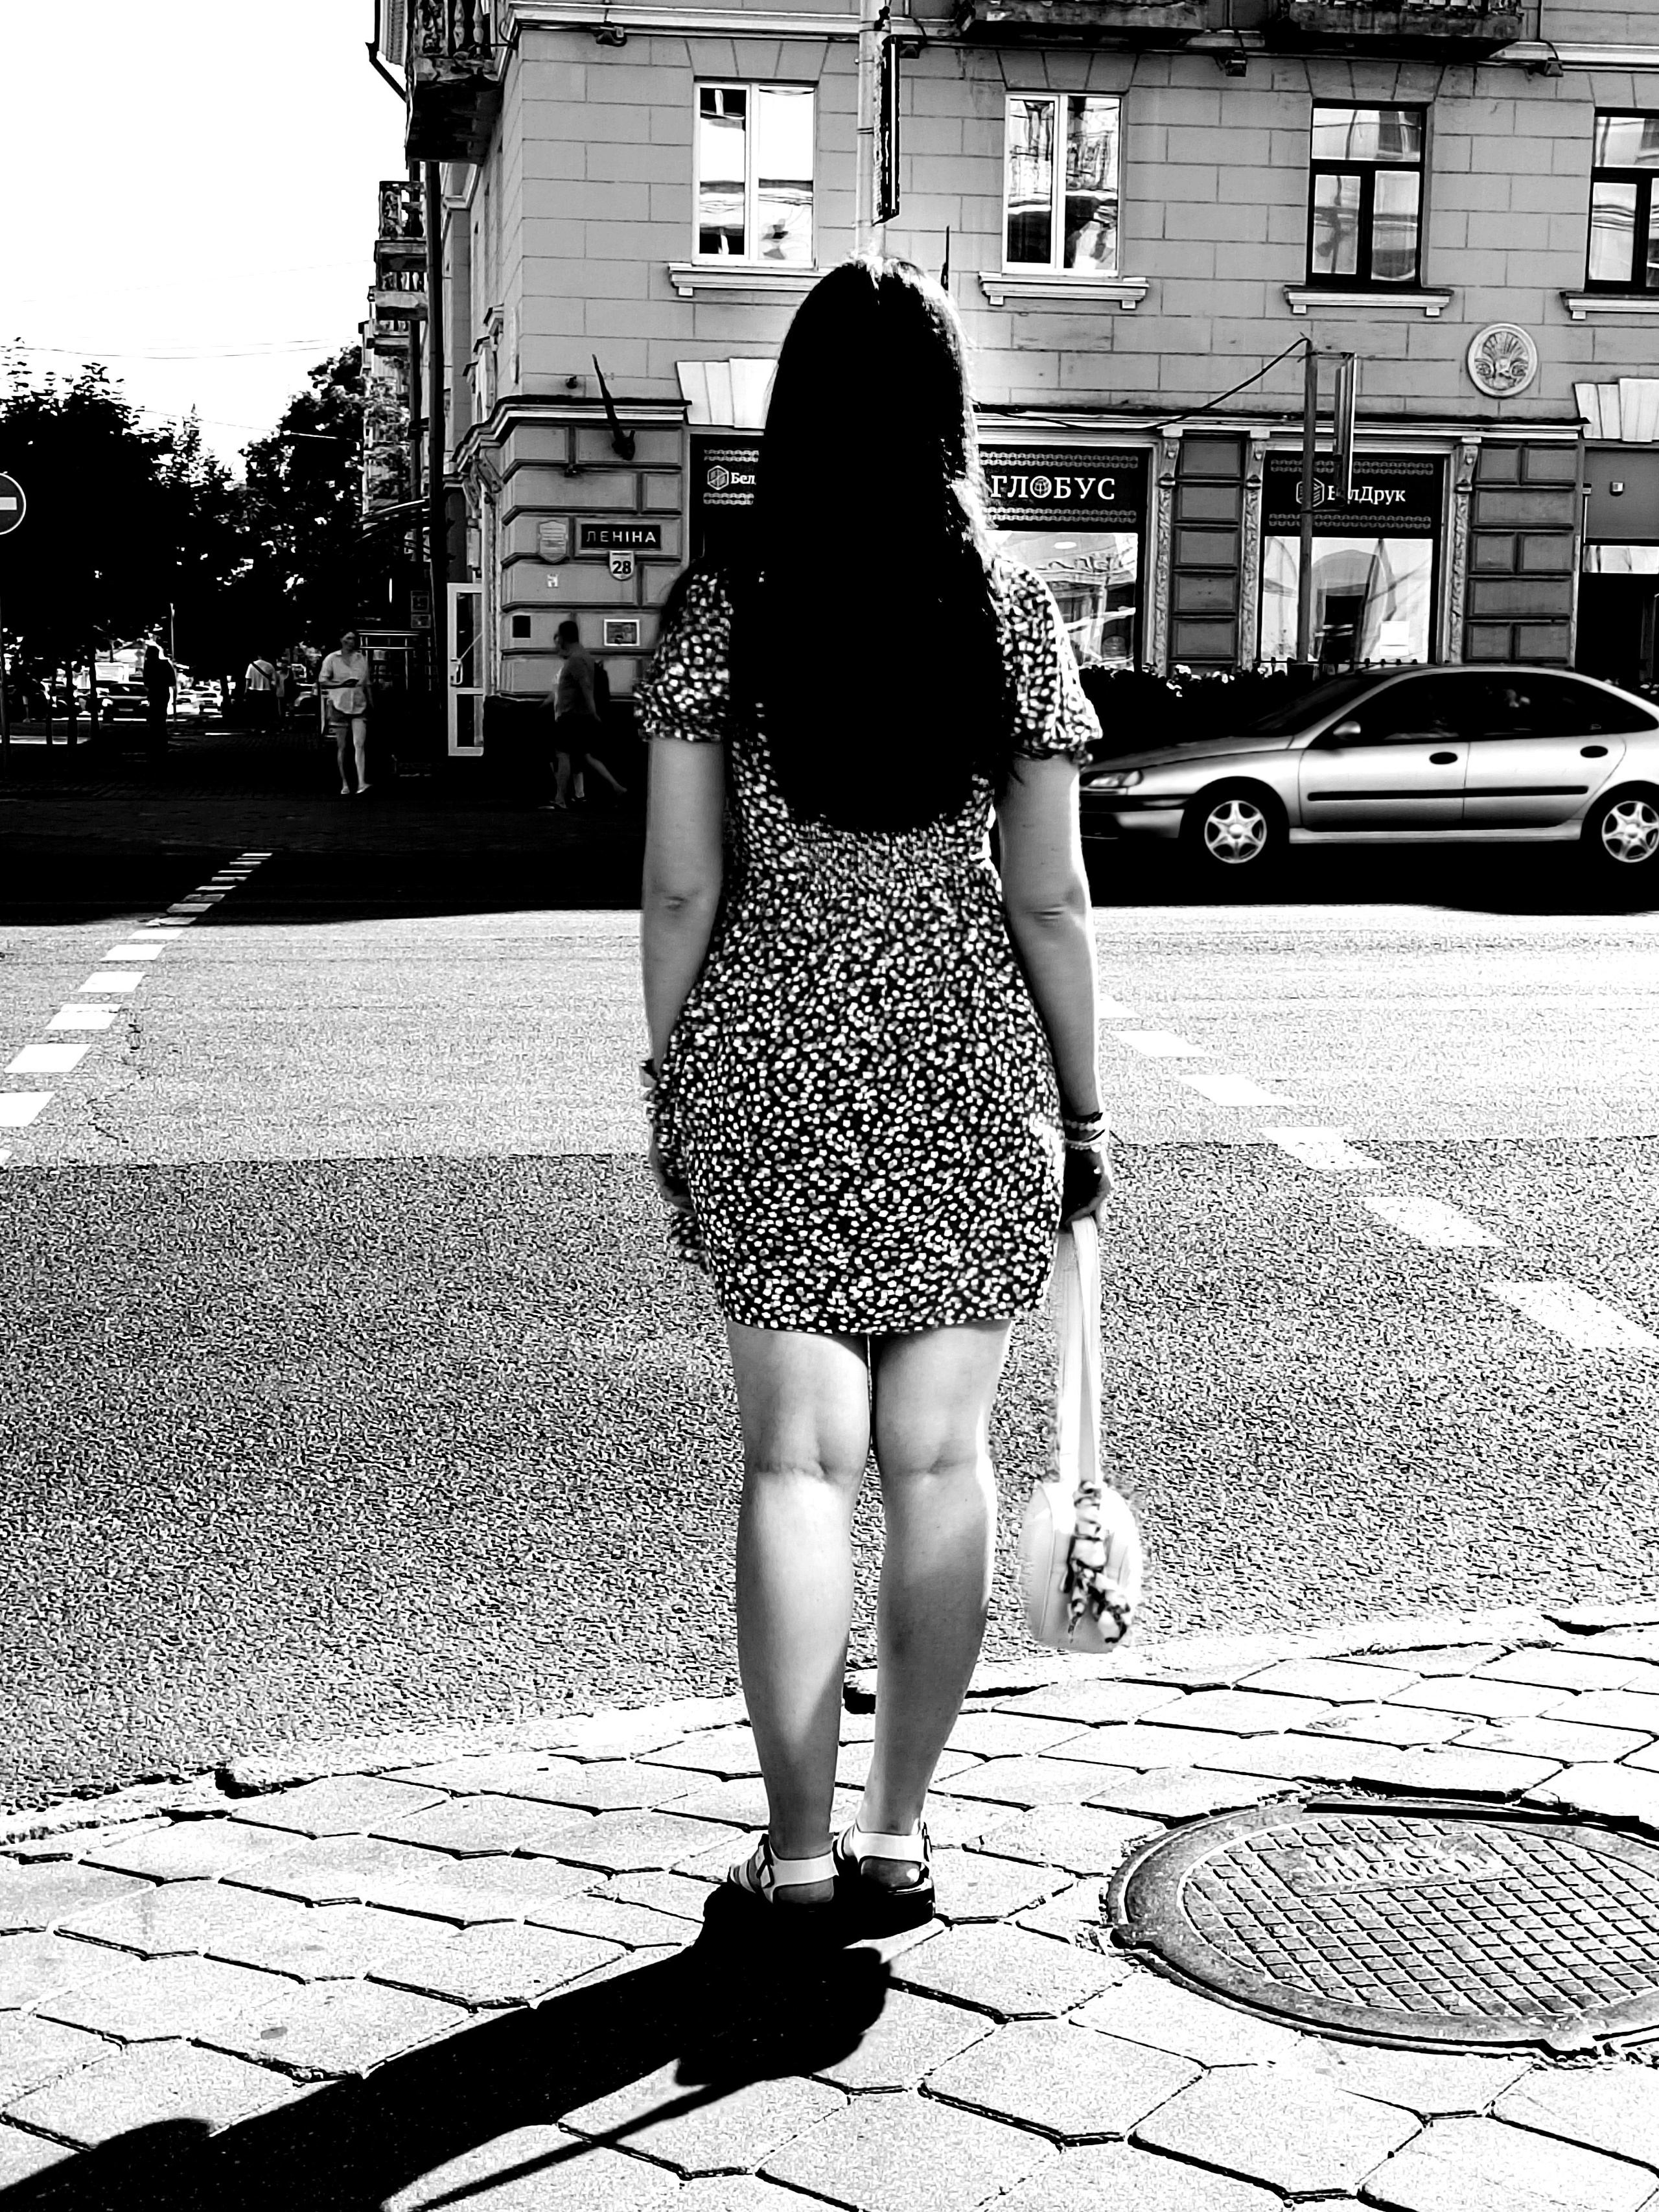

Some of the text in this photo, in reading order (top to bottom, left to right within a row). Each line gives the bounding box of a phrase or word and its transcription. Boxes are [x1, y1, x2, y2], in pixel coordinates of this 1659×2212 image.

[730, 472, 756, 485] Бел
[990, 474, 1115, 500] ГЛОБУС
[1327, 485, 1406, 505] БлДрук
[586, 531, 656, 542] ЛЕНІНА
[612, 560, 631, 574] 28
